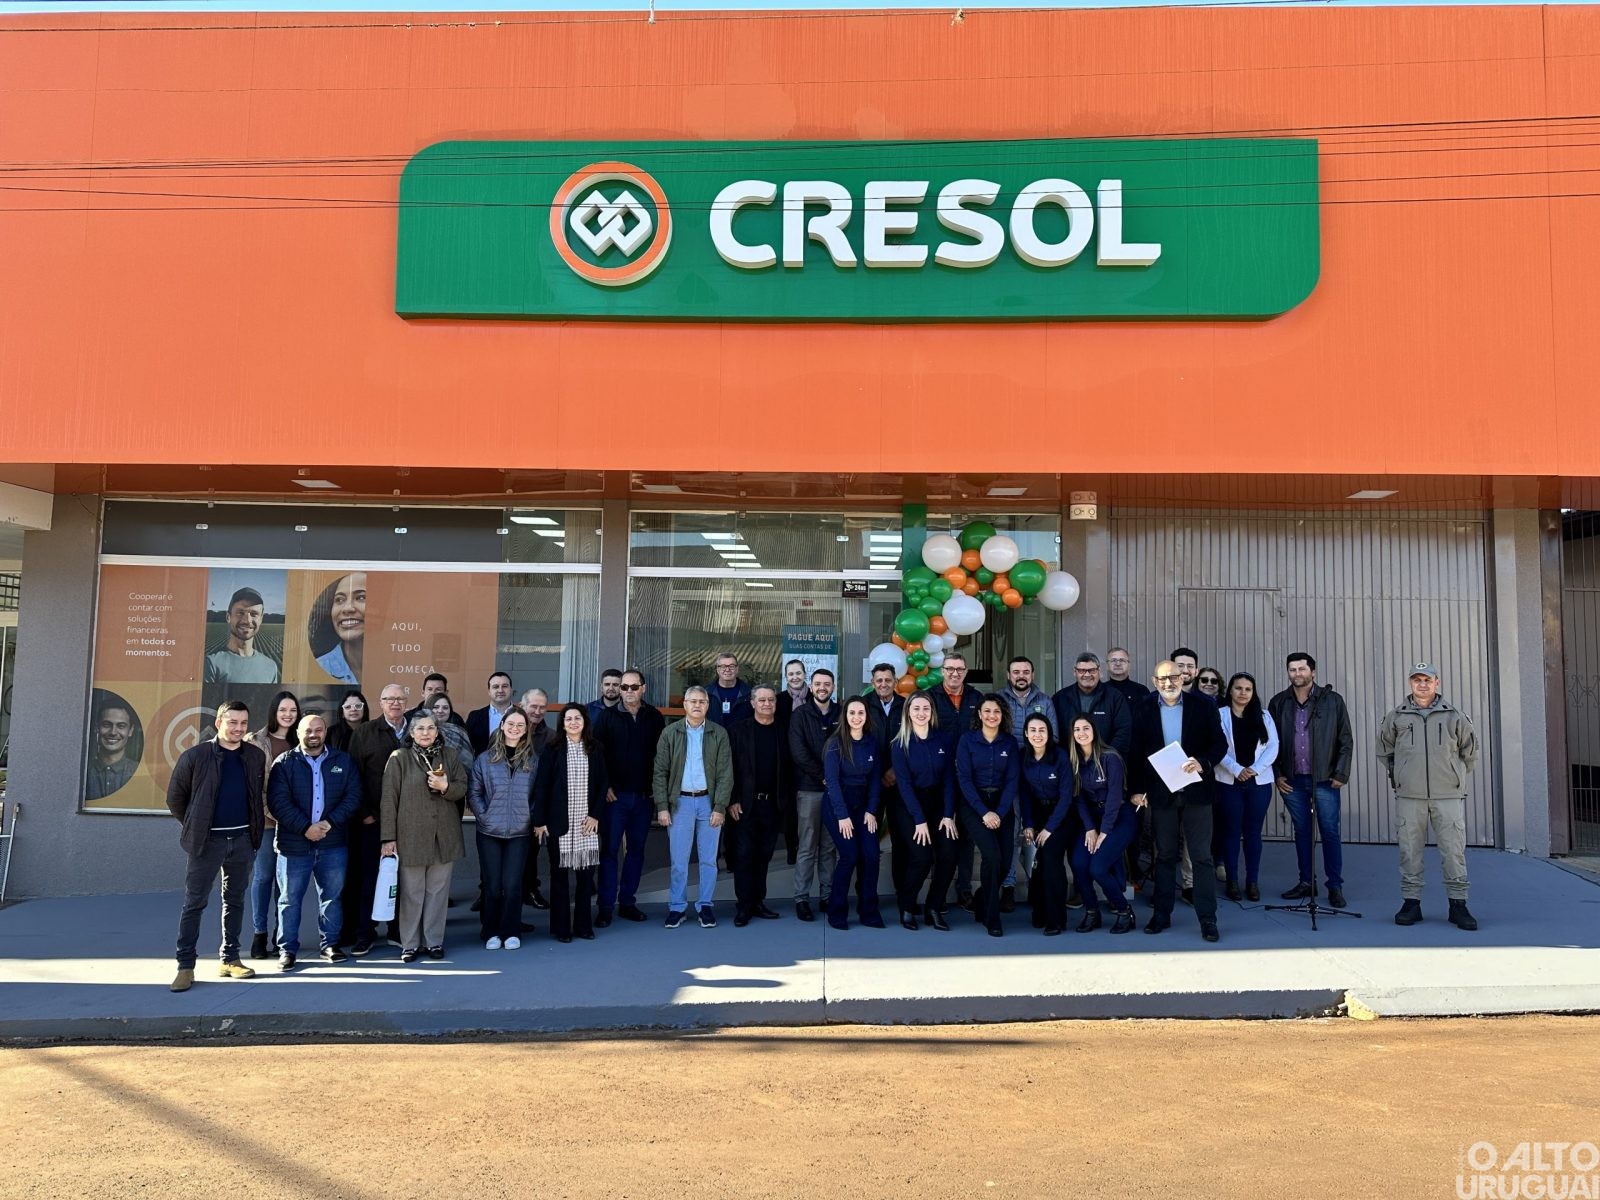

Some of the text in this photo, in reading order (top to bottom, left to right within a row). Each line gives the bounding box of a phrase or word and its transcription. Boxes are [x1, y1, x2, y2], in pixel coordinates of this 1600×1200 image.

[709, 178, 1162, 268] CRESOL
[128, 592, 167, 601] Cooperar
[127, 615, 161, 624] soluções
[391, 622, 422, 632] AQUI,
[141, 637, 165, 645] todos
[787, 633, 834, 642] PAGUE AQUI
[391, 643, 421, 652] TUDO
[125, 649, 172, 657] momentos.
[389, 665, 435, 675] COMEÇA
